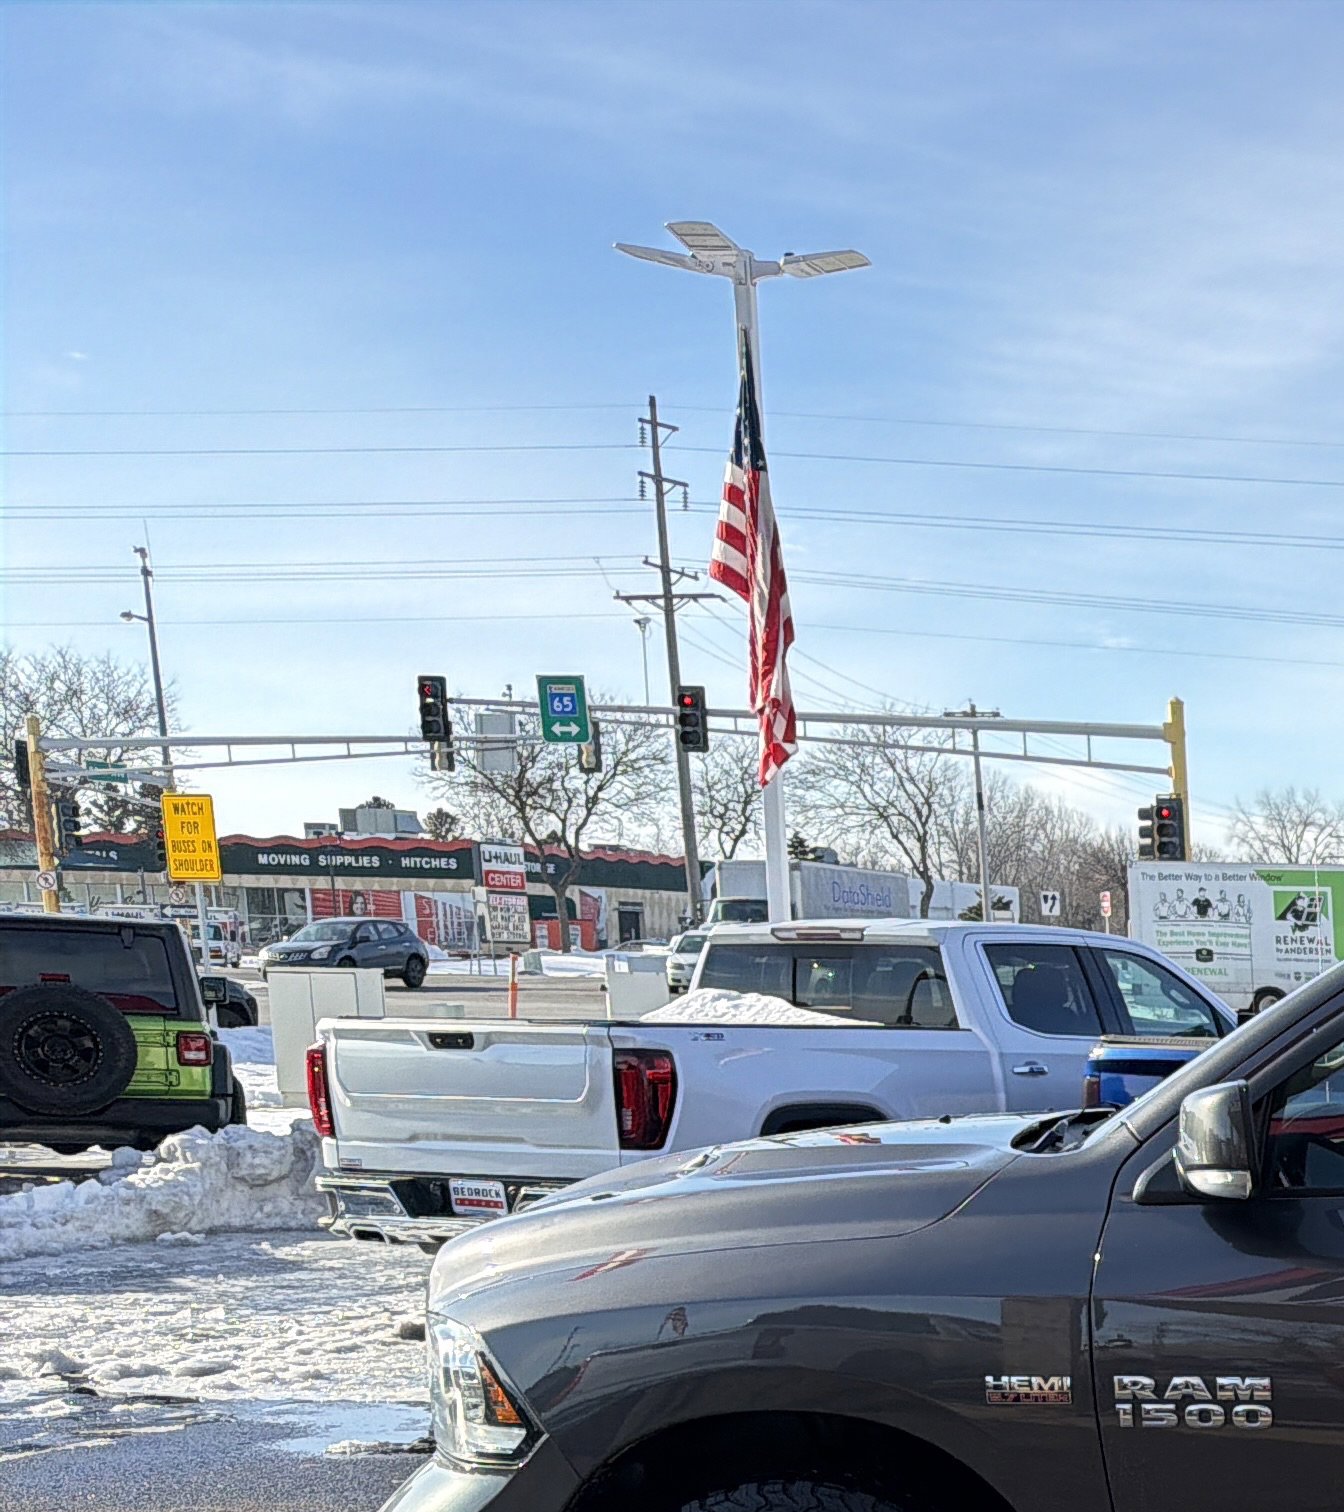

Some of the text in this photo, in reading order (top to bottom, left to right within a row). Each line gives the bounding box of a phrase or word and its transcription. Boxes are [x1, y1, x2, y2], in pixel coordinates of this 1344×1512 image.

[553, 697, 573, 712] 65
[172, 802, 204, 816] WATCH
[181, 821, 199, 834] FOR
[171, 840, 213, 854] BUSES ON
[258, 853, 458, 870] MOVING SUPPLIES HITCHES
[482, 850, 524, 866] U-HAUL
[173, 859, 215, 872] SHOULDER
[524, 862, 556, 874] STORGE
[487, 873, 523, 887] CENTER
[1141, 872, 1156, 880] The
[1158, 872, 1182, 881] Better
[1185, 872, 1202, 882] Way
[1204, 873, 1213, 881] to
[1222, 872, 1247, 881] Better
[832, 881, 892, 908] DataShield
[1275, 936, 1331, 946] RENEWAL
[453, 1186, 501, 1199] BEDROCK
[985, 1375, 1071, 1391] HEMI
[1113, 1375, 1273, 1400] RAM
[1020, 1393, 1068, 1401] LITER
[1114, 1403, 1273, 1429] 1500
